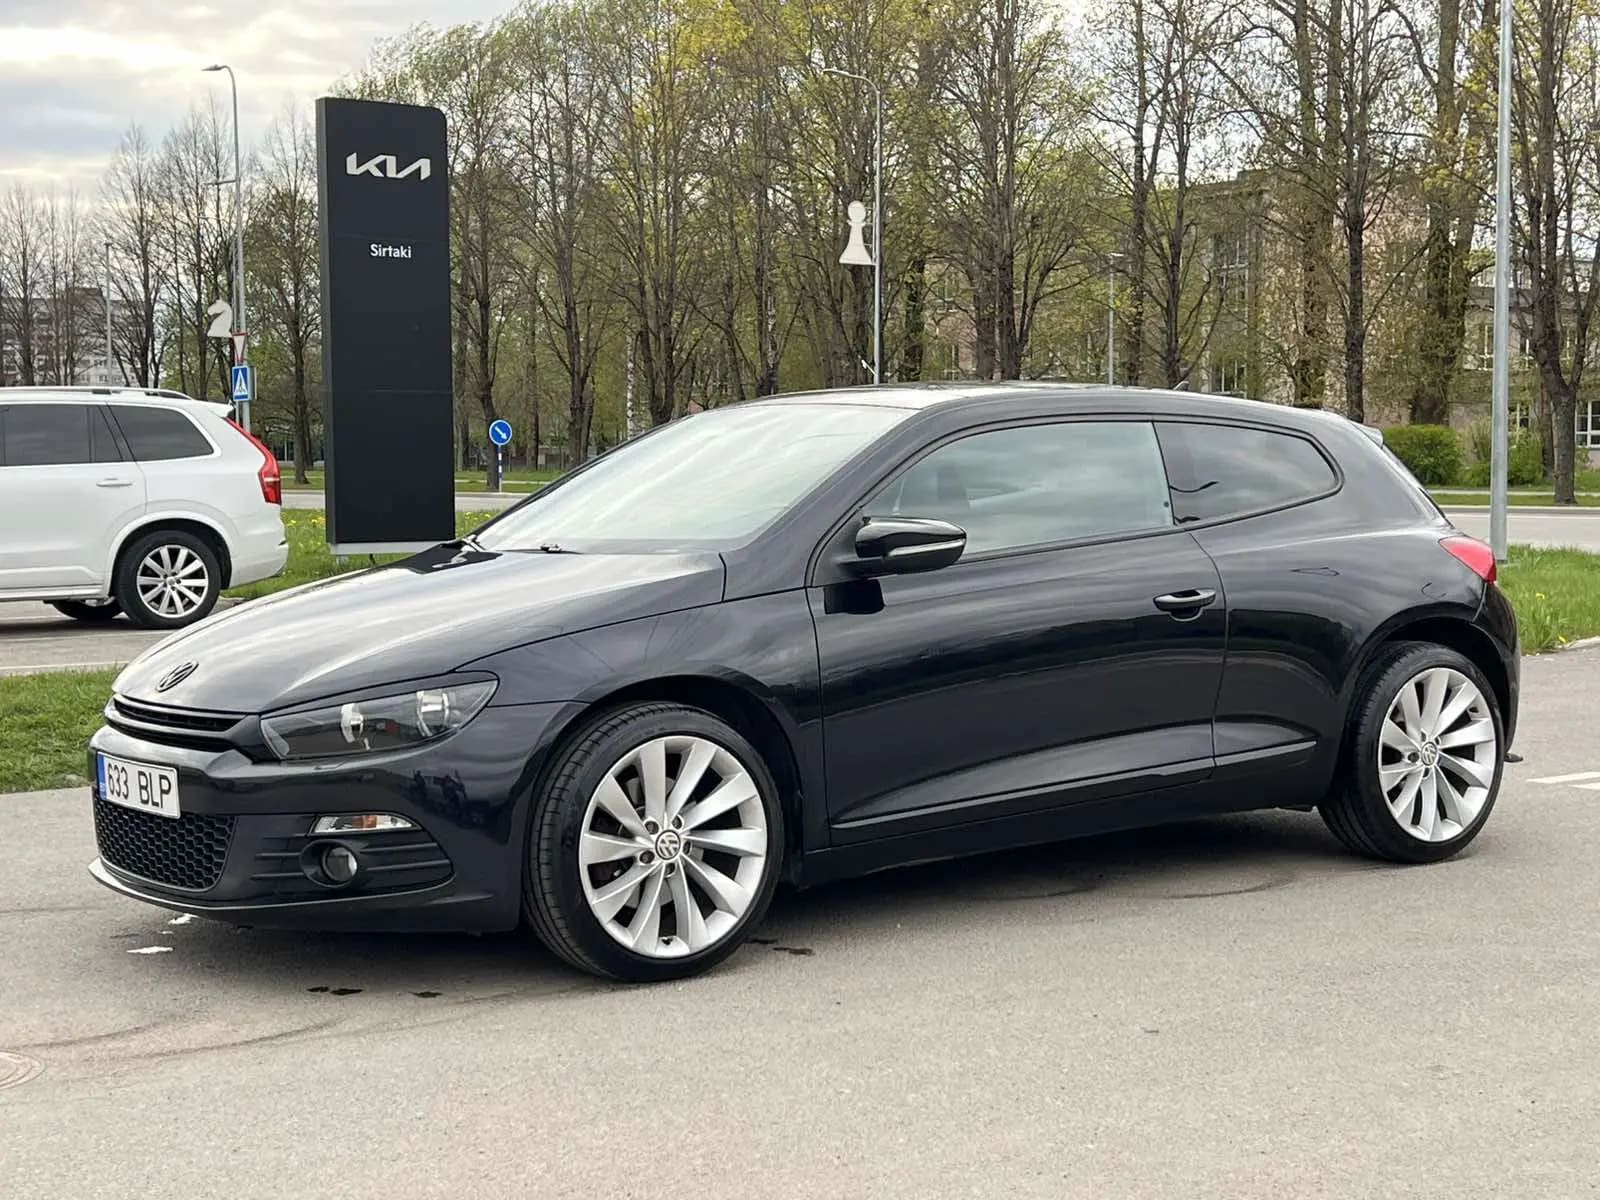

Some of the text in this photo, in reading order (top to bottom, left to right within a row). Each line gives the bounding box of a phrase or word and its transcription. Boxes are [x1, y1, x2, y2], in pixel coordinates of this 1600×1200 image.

[346, 152, 431, 181] KIA
[370, 243, 412, 259] Sirtaki
[108, 762, 130, 800] 633
[137, 770, 172, 809] BLP
